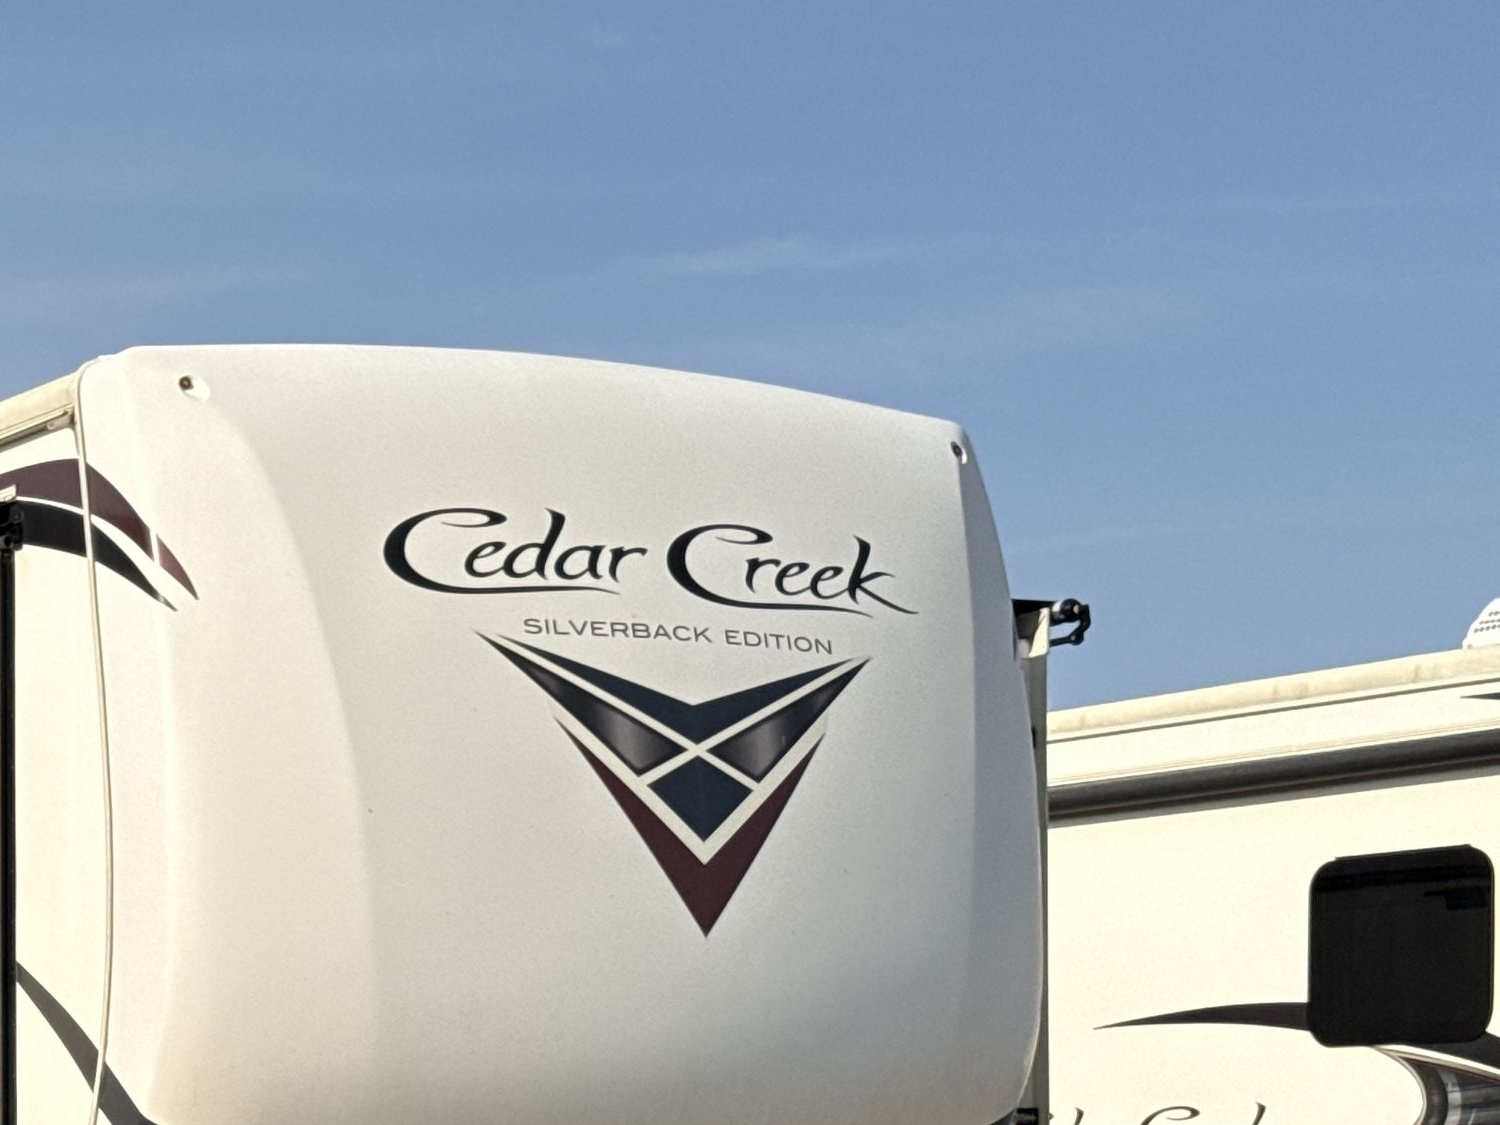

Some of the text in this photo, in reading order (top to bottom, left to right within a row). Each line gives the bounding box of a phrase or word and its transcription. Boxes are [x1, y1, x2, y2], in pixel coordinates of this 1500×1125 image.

[383, 506, 919, 618] Cedar Creek
[523, 617, 833, 655] SILVERBACK EDITION
